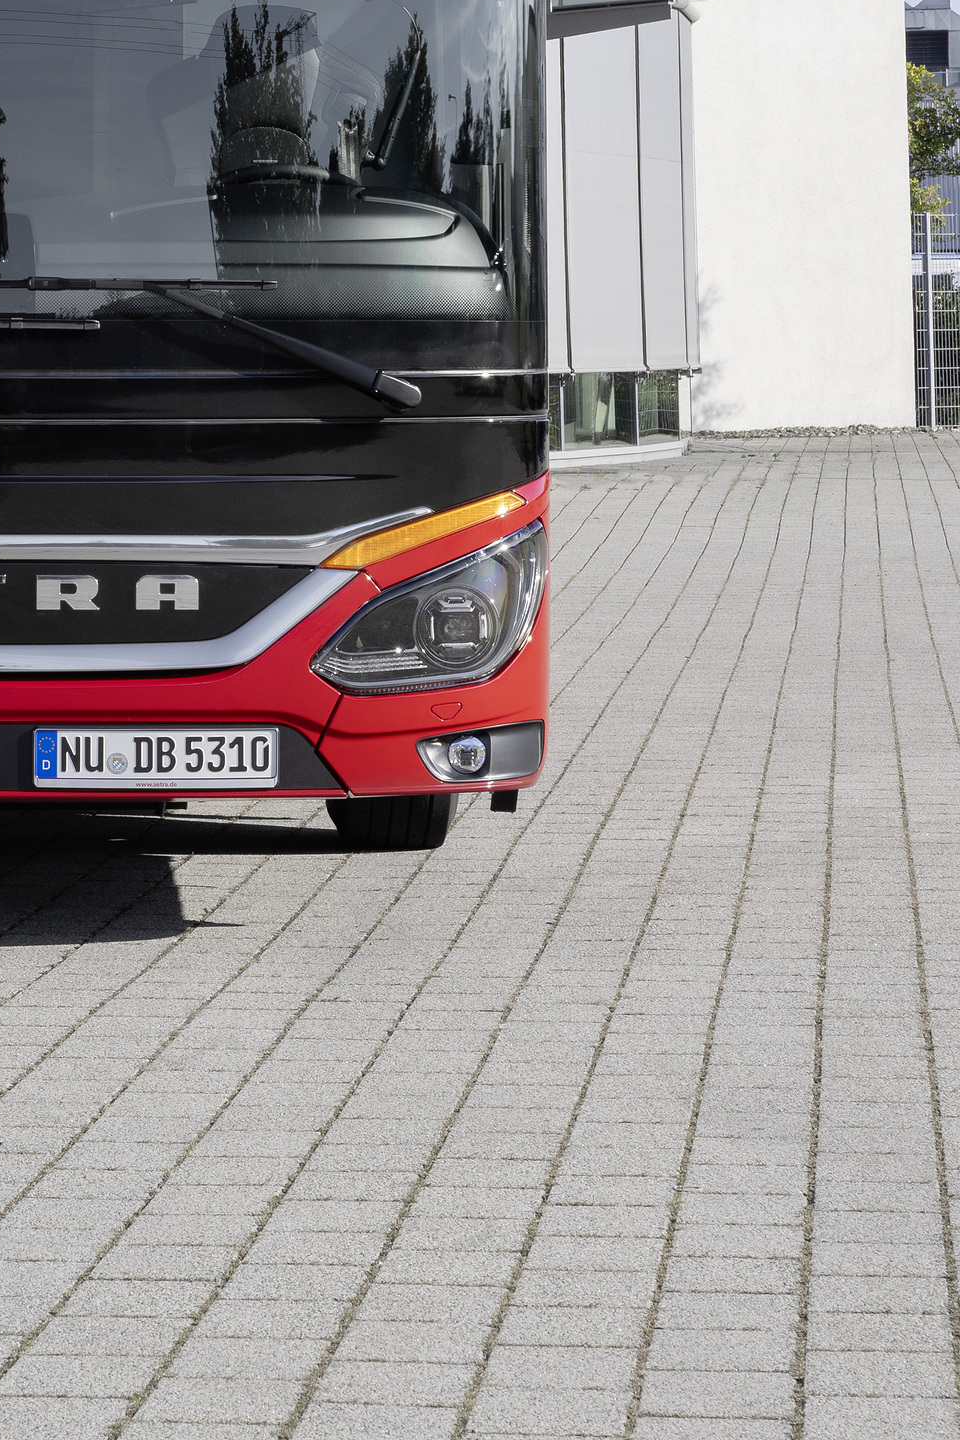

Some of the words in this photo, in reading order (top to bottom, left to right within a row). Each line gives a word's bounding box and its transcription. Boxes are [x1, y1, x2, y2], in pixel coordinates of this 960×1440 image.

[41, 759, 51, 770] D
[60, 736, 104, 773] NU
[133, 736, 177, 773] DB
[185, 736, 270, 773] 5310
